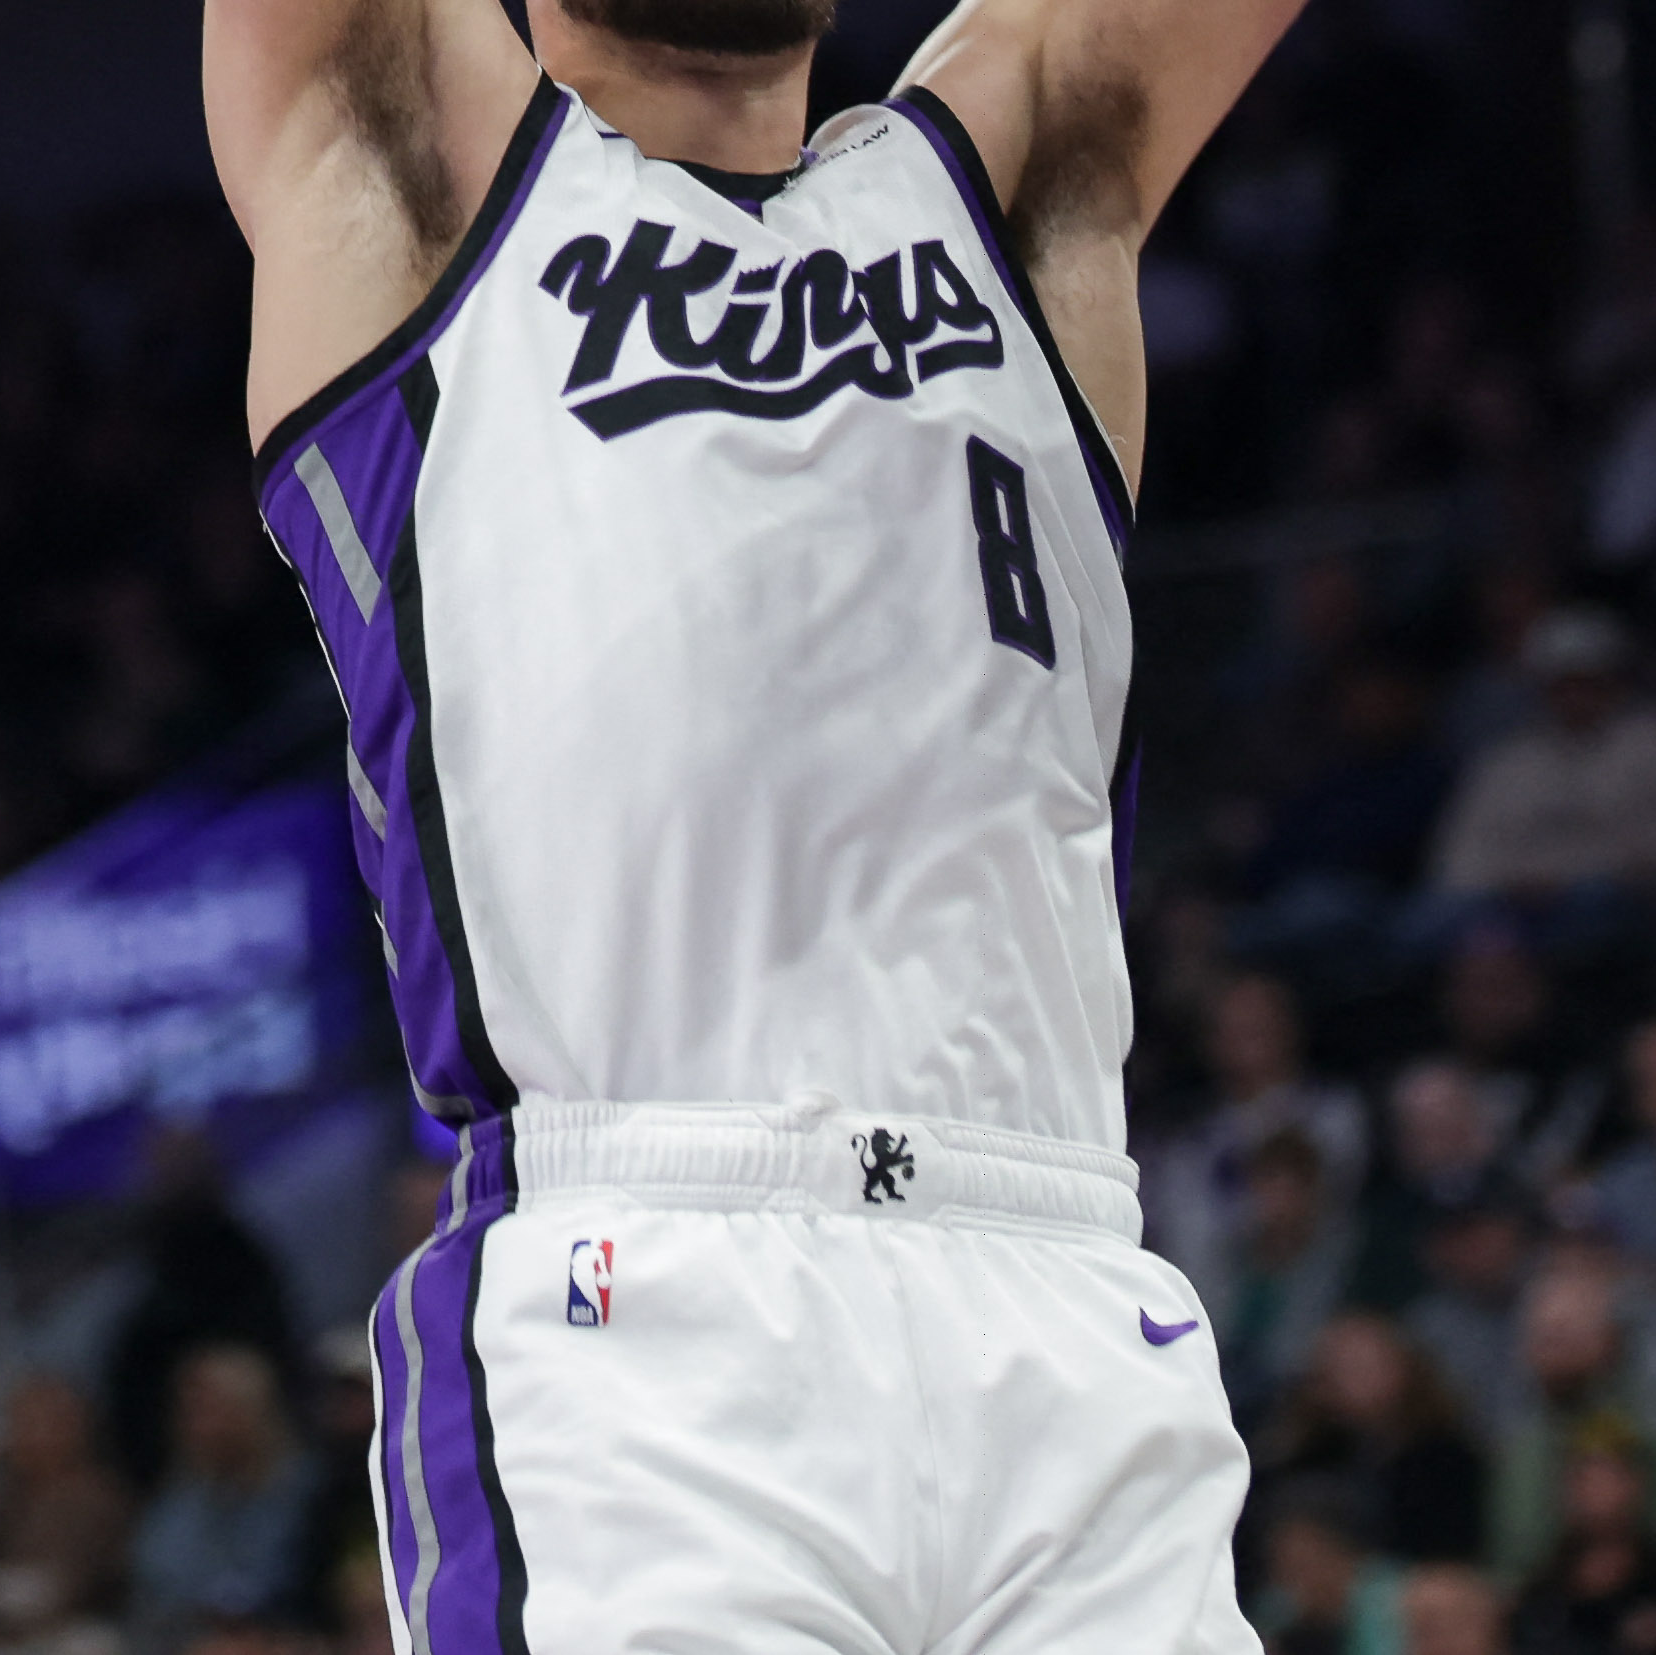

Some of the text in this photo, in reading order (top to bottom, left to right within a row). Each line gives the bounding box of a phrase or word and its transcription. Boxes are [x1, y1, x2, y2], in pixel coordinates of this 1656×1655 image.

[539, 220, 1003, 440] Kings
[965, 434, 1057, 672] 8
[571, 1305, 595, 1325] NBA
